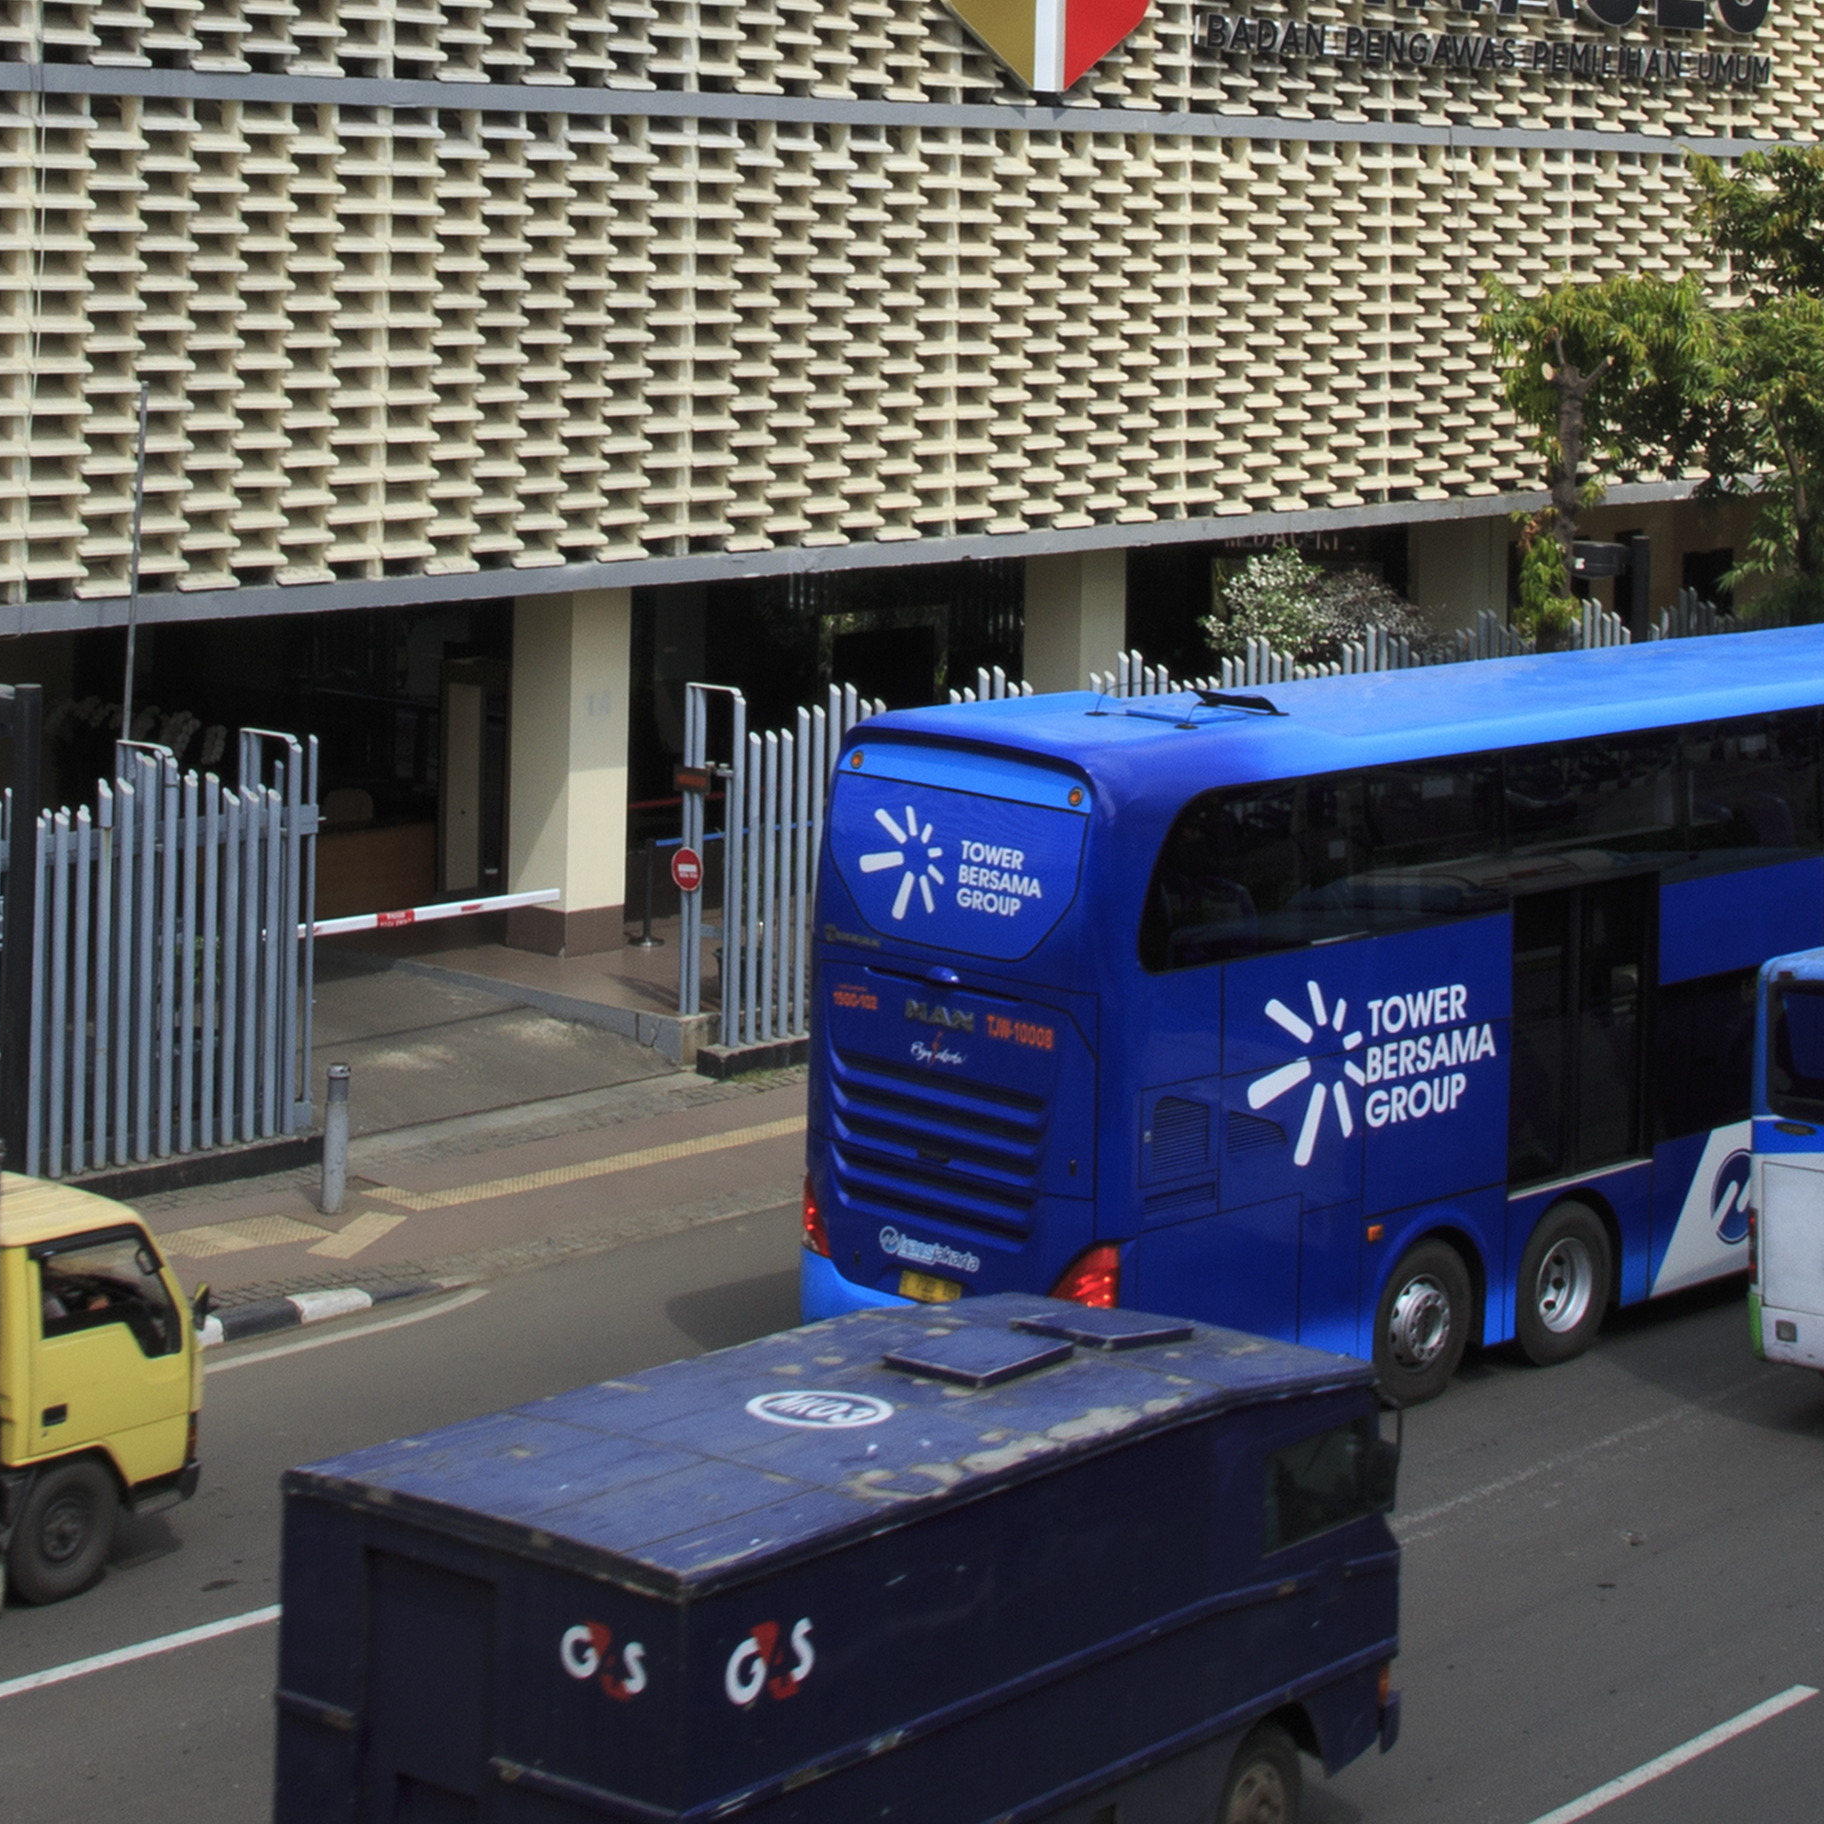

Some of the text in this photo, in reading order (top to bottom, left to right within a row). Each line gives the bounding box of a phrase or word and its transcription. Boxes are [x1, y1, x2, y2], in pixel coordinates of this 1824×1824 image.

[1205, 13, 1772, 84] BADAN PENGAWAS PEMILIHAN UMUM
[958, 863, 1042, 899] BERSAMA
[961, 840, 1025, 871] TOWER
[956, 888, 1022, 917] GROUP
[905, 999, 974, 1034] MAN
[1367, 984, 1468, 1037] TOWER
[1366, 1023, 1497, 1084] BERSAMA
[1365, 1072, 1467, 1128] GROUP
[560, 1621, 647, 1703] G4S
[725, 1616, 815, 1706] G4S
